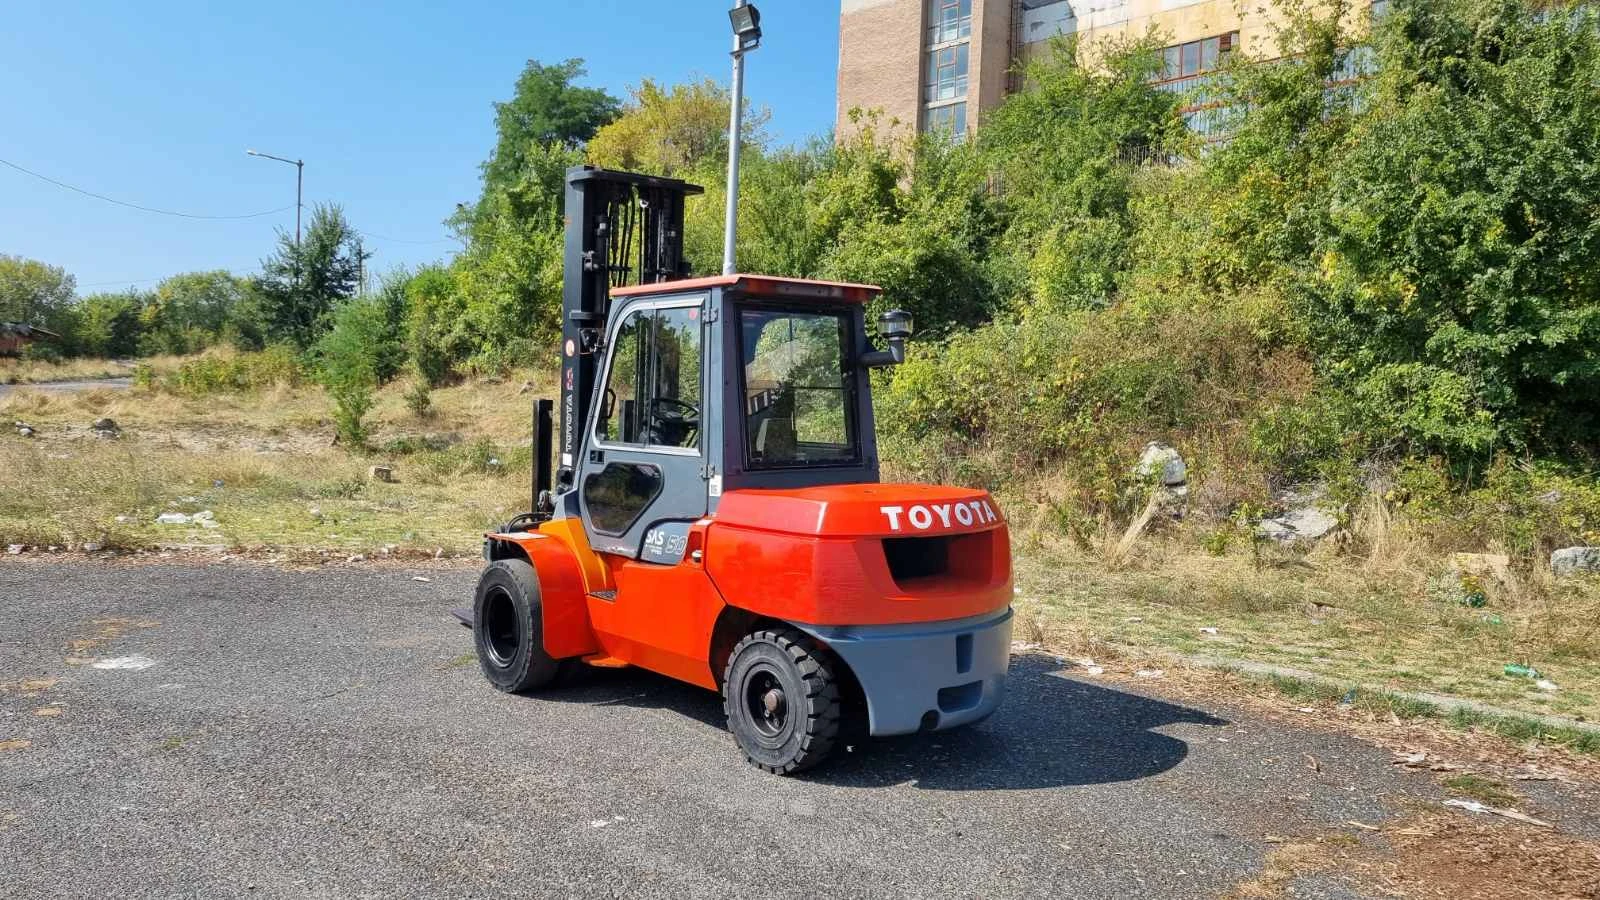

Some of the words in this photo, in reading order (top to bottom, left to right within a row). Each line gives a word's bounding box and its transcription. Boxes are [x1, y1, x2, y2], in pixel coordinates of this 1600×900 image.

[565, 394, 573, 452] TOYOTA
[880, 500, 997, 530] TOYOTA
[645, 529, 665, 545] SAS
[665, 535, 688, 555] 50
